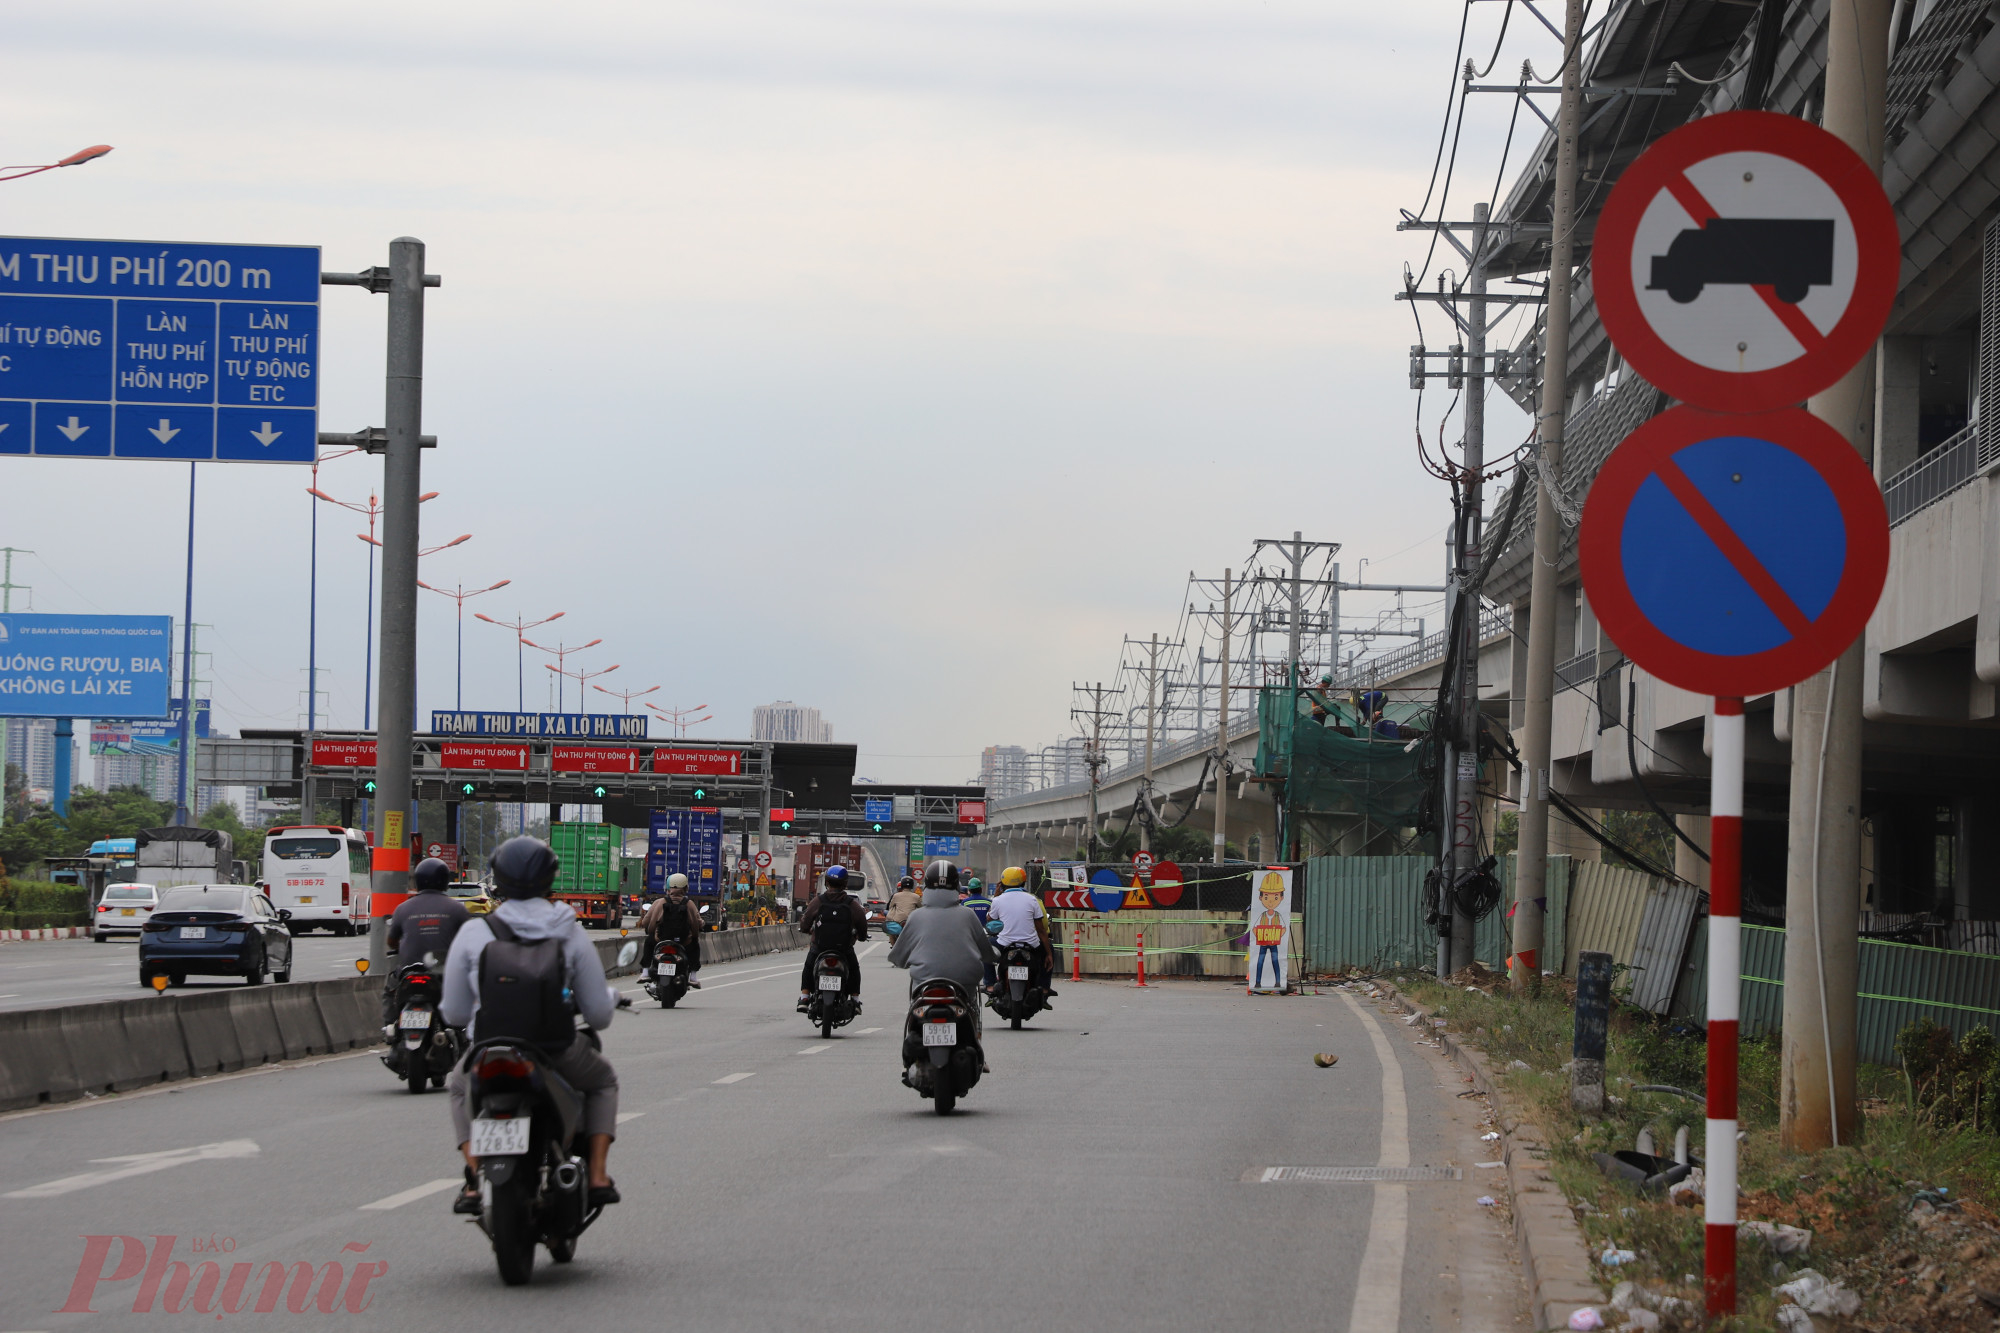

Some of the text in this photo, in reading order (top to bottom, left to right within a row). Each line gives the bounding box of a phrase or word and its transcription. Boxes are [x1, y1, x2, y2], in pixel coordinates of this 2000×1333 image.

[30, 254, 98, 284] THU
[110, 251, 169, 286] PHÍ
[176, 259, 231, 287] 200
[242, 267, 271, 289] m
[147, 311, 187, 332] LÀN
[249, 309, 288, 330] LÀN
[14, 326, 42, 348] TỰ
[45, 325, 102, 349] ĐỘNG
[230, 334, 309, 354] THU PHÍ
[127, 341, 207, 361] THU PHÍ
[121, 365, 209, 393] HỖN HỢP
[224, 358, 310, 381] TỰ ĐỘNG
[250, 384, 285, 402] ETC
[61, 656, 125, 675] RƯỢU,
[130, 658, 163, 673] BIA
[71, 677, 102, 695] LÁI
[106, 680, 132, 695] XE
[434, 712, 645, 739] TRẠM THU PHÍ XA LỘ HÀ NỘI
[315, 744, 329, 752] LÀN
[497, 748, 516, 757] ĐỘNG
[554, 750, 568, 758] LÀN
[607, 752, 626, 760] ĐỘNG
[656, 752, 670, 760] LÀN
[686, 753, 698, 761] PHÍ
[709, 754, 728, 763] ĐỘNG
